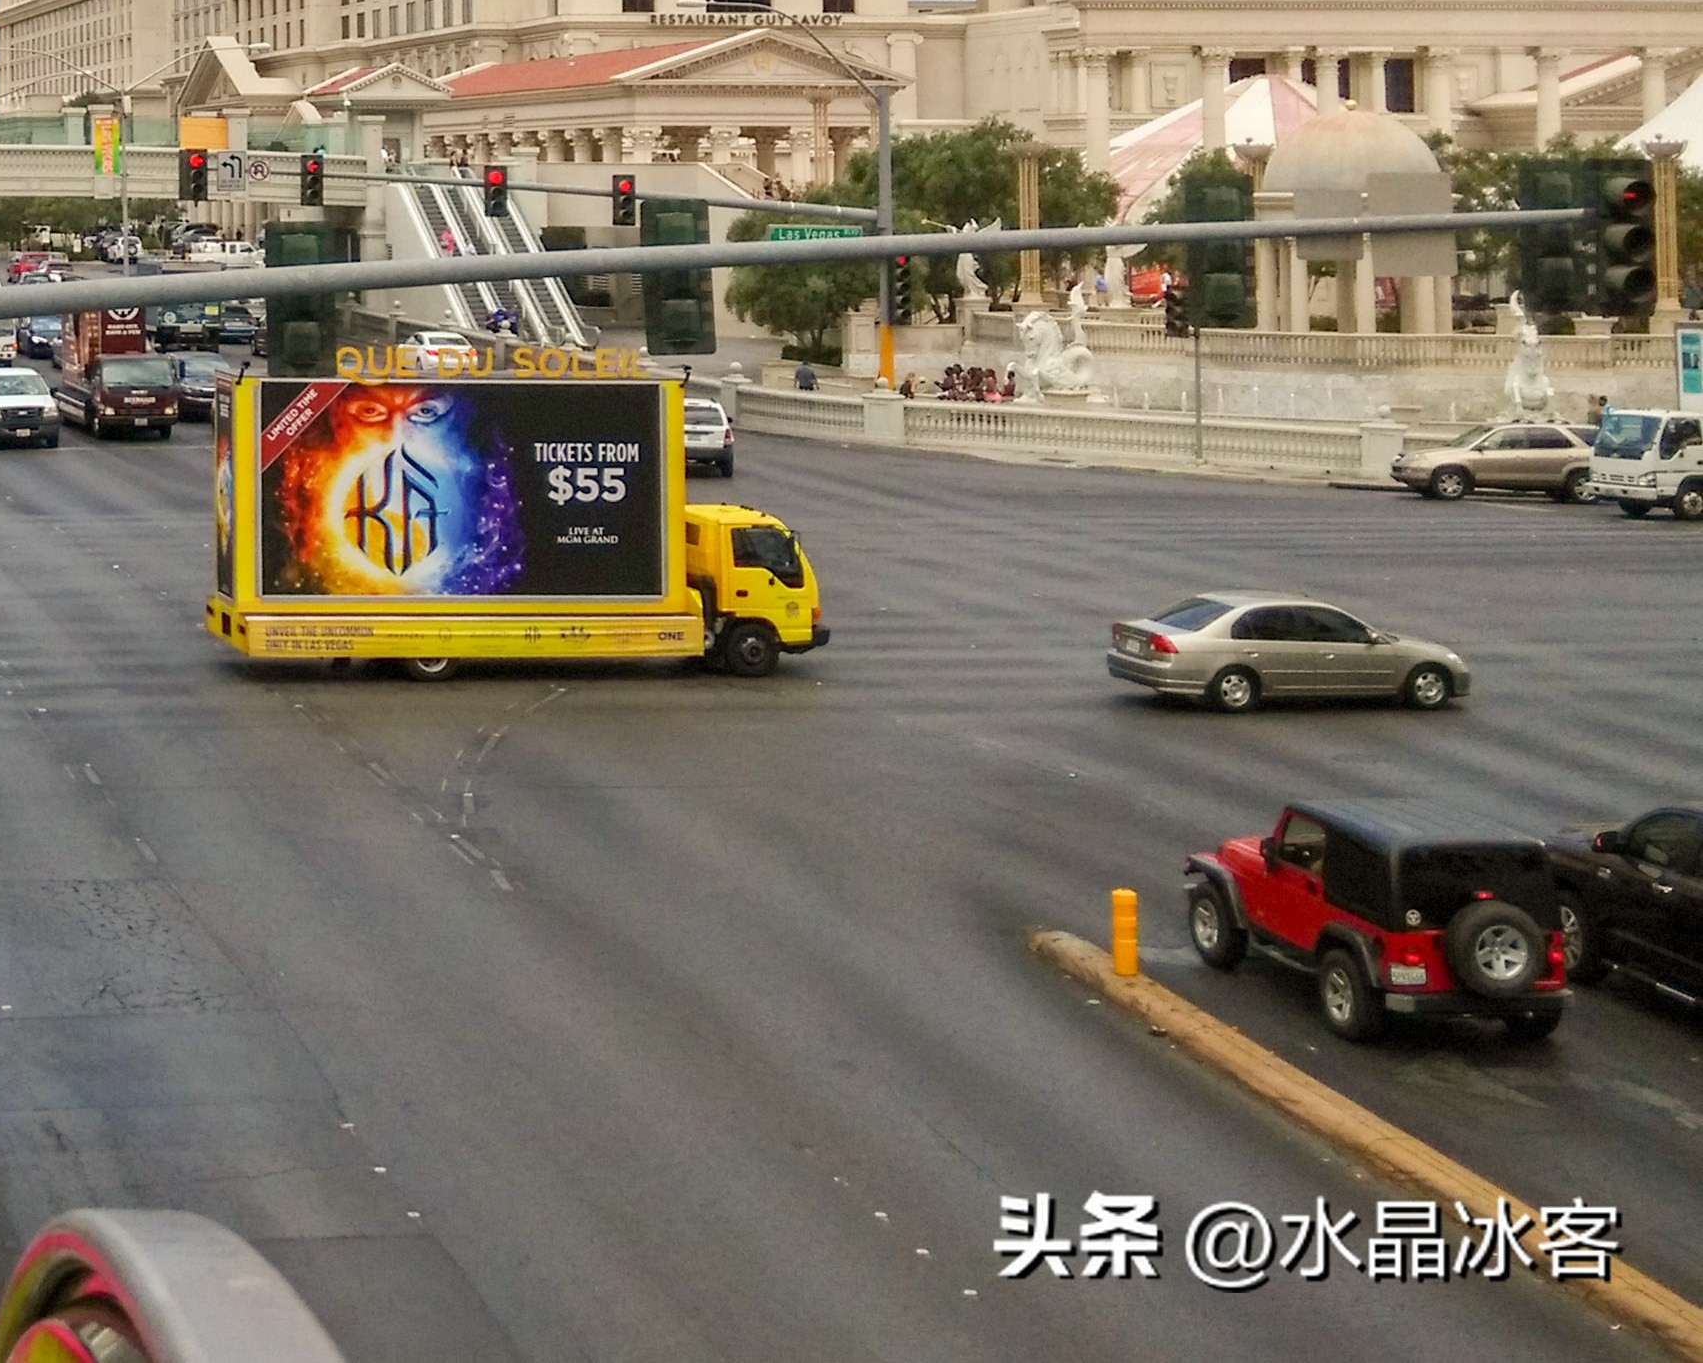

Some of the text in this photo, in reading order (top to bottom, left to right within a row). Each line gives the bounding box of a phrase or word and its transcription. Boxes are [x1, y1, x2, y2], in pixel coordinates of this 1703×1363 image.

[650, 14, 748, 26] RESTAURANT
[754, 14, 786, 26] GUY
[778, 228, 800, 240] Las
[804, 228, 841, 240] Vegas
[336, 345, 649, 386] QUE DU SOLEIL
[266, 388, 318, 441] LIMITED TIME
[286, 408, 314, 436] OFFER
[534, 442, 640, 463] TICKETS FROM
[548, 465, 627, 506] $55
[568, 526, 605, 535] LIVE AT
[556, 536, 619, 544] MGM GRAND
[300, 626, 318, 637] THE
[658, 631, 684, 641] ONE
